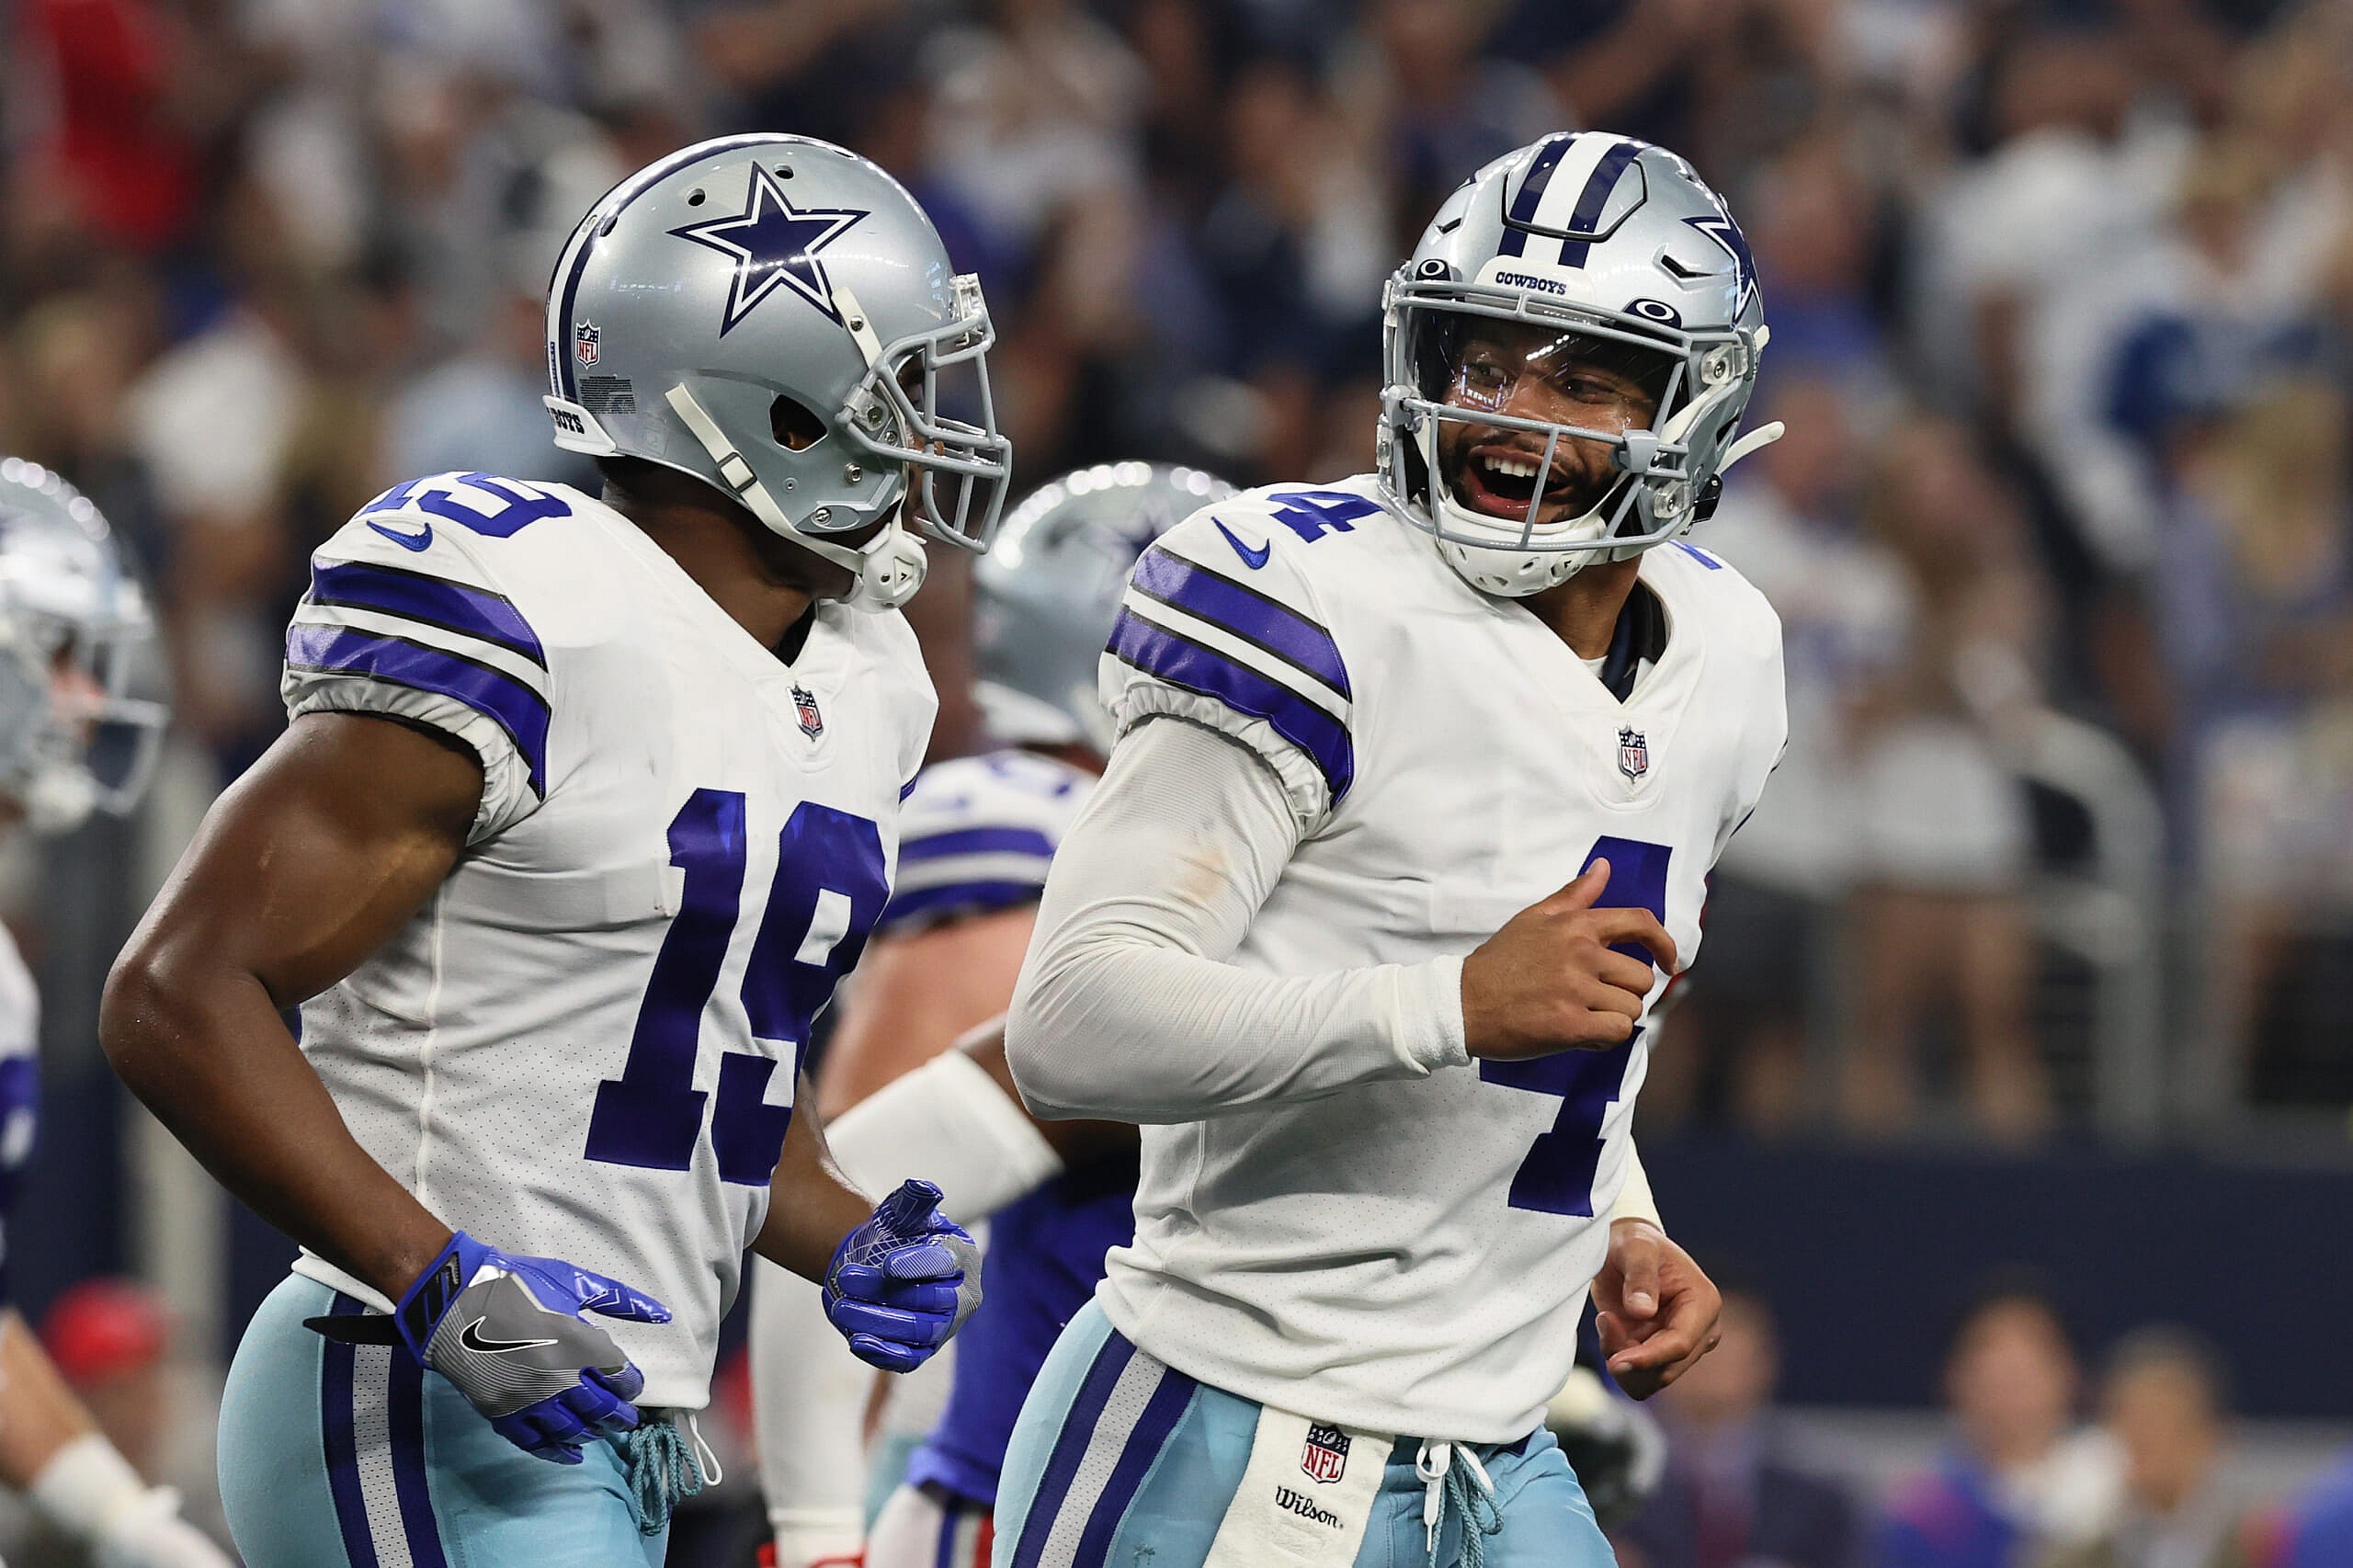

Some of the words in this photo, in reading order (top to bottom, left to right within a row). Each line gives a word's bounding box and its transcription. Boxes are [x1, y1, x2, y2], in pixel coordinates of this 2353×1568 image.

[1495, 271, 1567, 295] COWBOYS
[578, 341, 597, 361] NFL
[546, 406, 585, 434] BOYS
[1266, 491, 1388, 543] 4
[1623, 747, 1645, 770] NFL
[584, 787, 890, 1187] 19
[1303, 1444, 1340, 1480] NFL
[1275, 1485, 1339, 1529] Wilson
